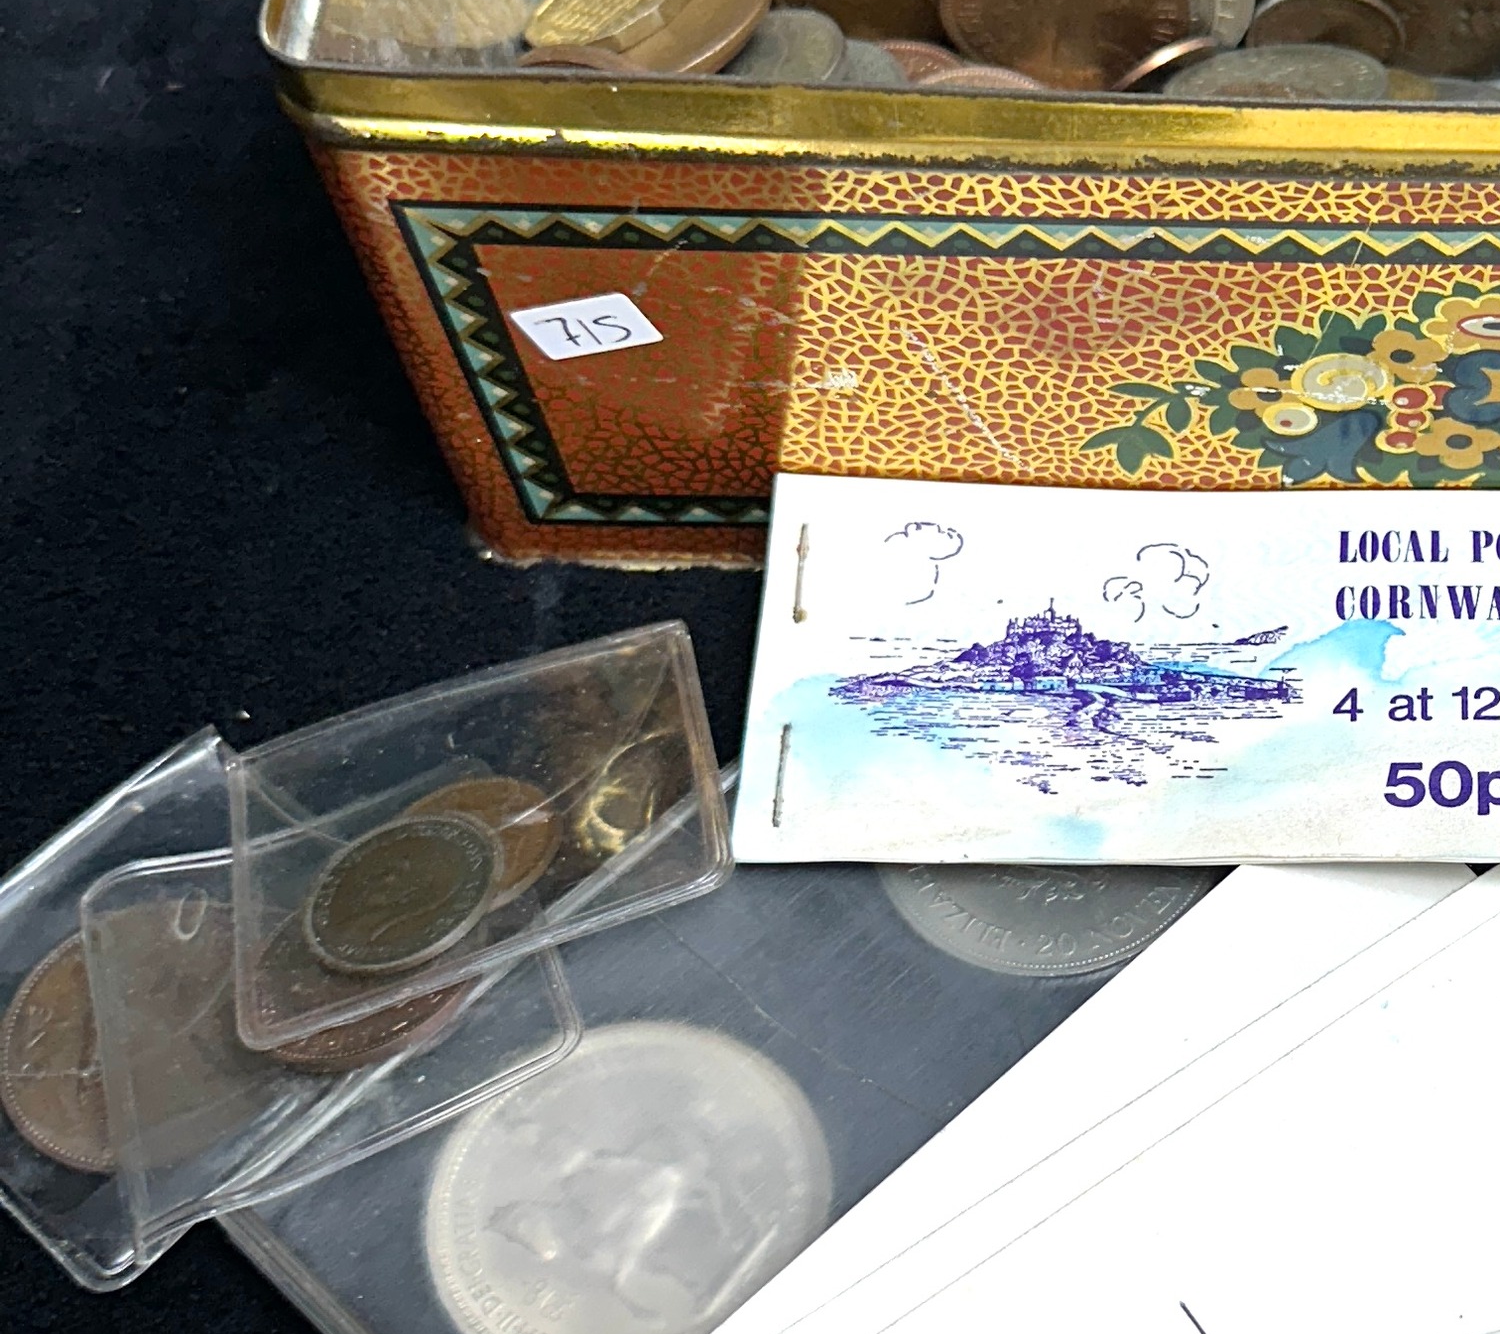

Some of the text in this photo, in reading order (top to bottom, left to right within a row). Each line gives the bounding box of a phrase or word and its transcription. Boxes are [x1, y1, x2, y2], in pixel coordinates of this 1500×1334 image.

[533, 315, 632, 347] 715
[1338, 530, 1449, 563] LOCAL
[1333, 687, 1364, 722] 4
[1388, 687, 1433, 721] at
